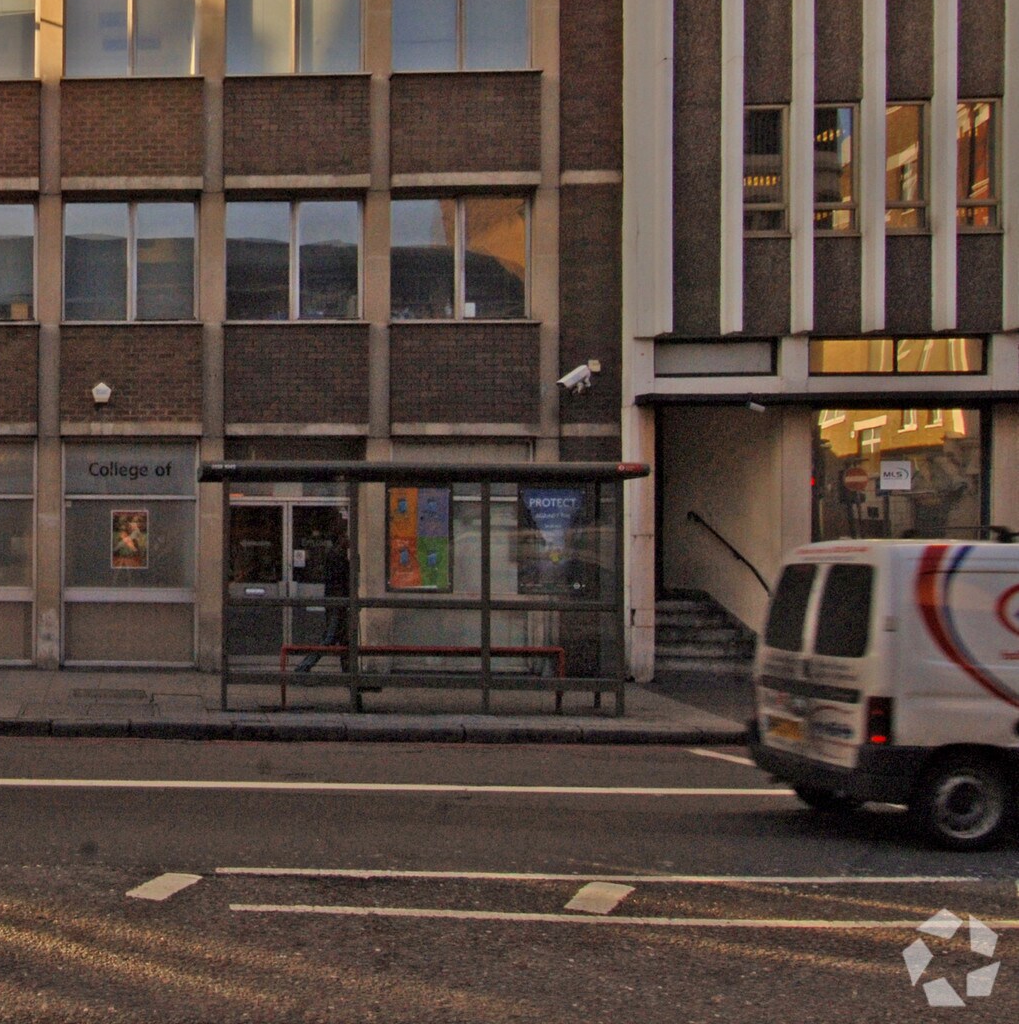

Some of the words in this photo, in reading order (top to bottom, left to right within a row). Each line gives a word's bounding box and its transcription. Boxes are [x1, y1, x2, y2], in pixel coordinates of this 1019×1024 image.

[89, 462, 148, 480] College
[154, 462, 172, 476] of
[528, 497, 578, 508] PROTECT
